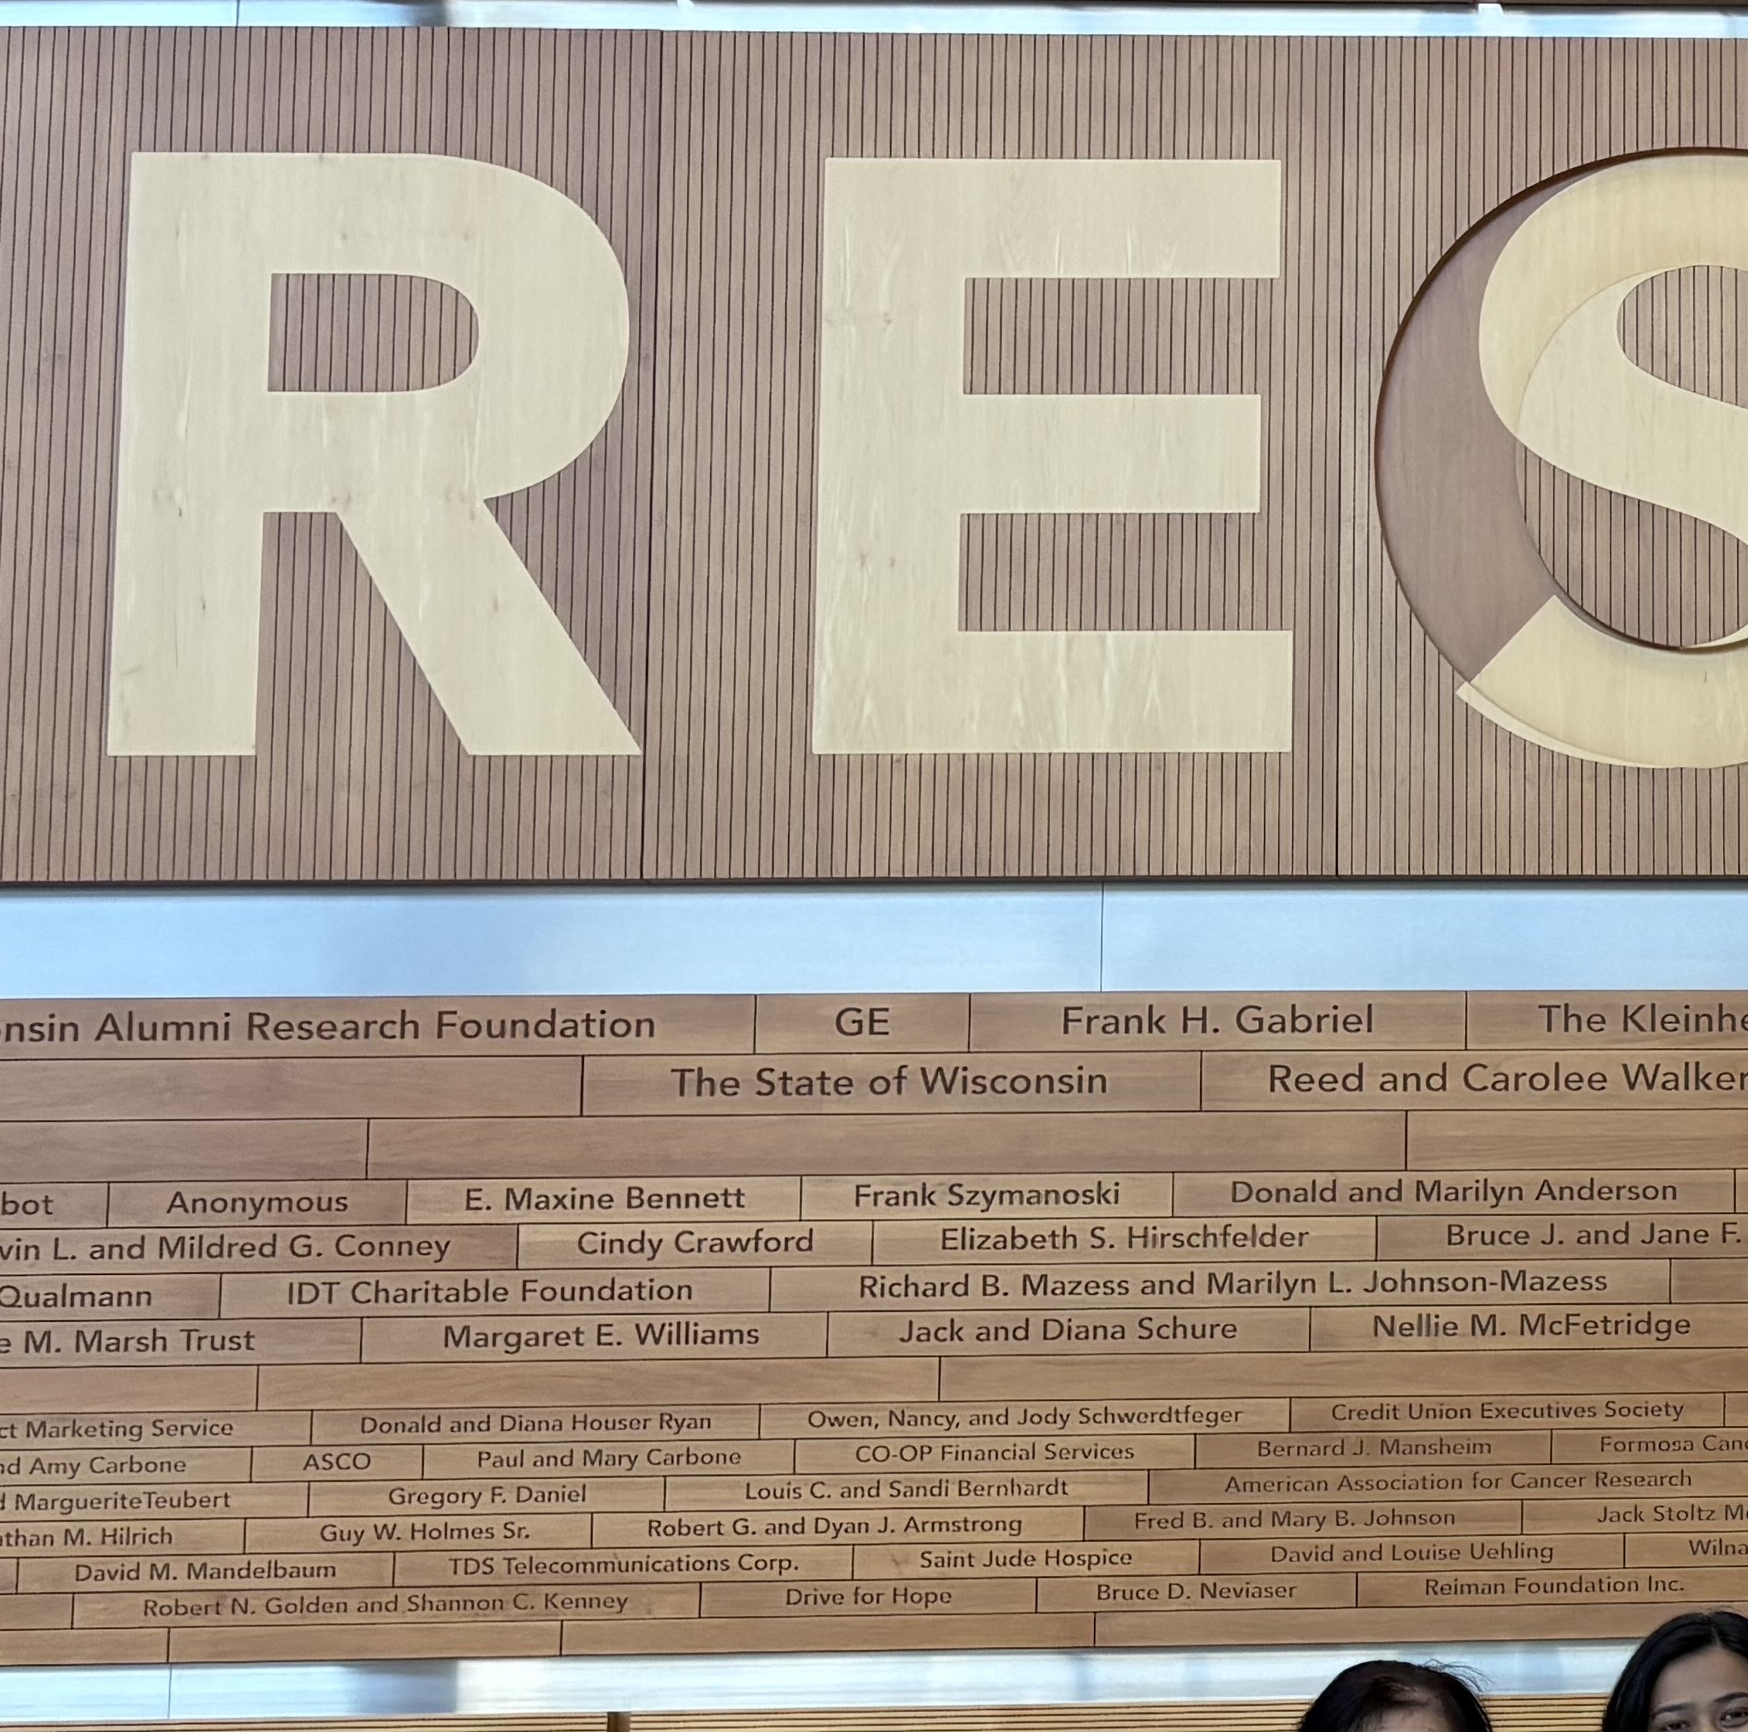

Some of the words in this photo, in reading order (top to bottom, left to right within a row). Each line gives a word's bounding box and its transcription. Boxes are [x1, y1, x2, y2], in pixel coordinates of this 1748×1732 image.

[94, 1010, 231, 1042] Alumni
[247, 1008, 420, 1041] Research
[436, 1007, 655, 1040] Foundation
[835, 1007, 890, 1037] GE
[1062, 1003, 1166, 1035] Frank
[1182, 1005, 1220, 1034] H.
[1235, 1003, 1373, 1034] Gabriel
[1537, 1002, 1607, 1033] The
[670, 1066, 741, 1097] The
[755, 1067, 854, 1097] State
[868, 1064, 909, 1096] of
[919, 1064, 1107, 1095] Wisconsin
[1269, 1061, 1364, 1093] Reed
[1378, 1061, 1447, 1093] and
[1462, 1061, 1608, 1092] Carolee
[166, 1190, 349, 1221] Anonymous
[465, 1187, 492, 1211] E.
[505, 1186, 615, 1211] Maxine
[626, 1186, 746, 1210] Bennett
[854, 1181, 937, 1208] Frank
[947, 1180, 1120, 1214] Szymanoski
[577, 1229, 664, 1262] Cindy
[674, 1227, 814, 1254] Crawford
[941, 1224, 1078, 1251] Elizabeth
[1090, 1225, 1115, 1250] S.
[1128, 1223, 1310, 1249] Hirschfelder
[288, 1281, 341, 1305] IDT
[350, 1278, 509, 1305] Charitable
[521, 1276, 693, 1303] Foundation
[444, 1324, 585, 1355] Margaret
[596, 1323, 623, 1347] E.
[634, 1320, 760, 1346] Williams
[898, 1317, 964, 1343] Jack
[975, 1316, 1030, 1343] and
[1042, 1317, 1126, 1341] Diana
[1137, 1314, 1238, 1340] Schure
[302, 1452, 372, 1471] ASCO
[855, 1444, 933, 1463] CO-OP
[941, 1441, 1036, 1462] Financial
[1044, 1442, 1135, 1461] Services
[388, 1486, 483, 1510] Gregory
[490, 1485, 507, 1504] F.
[516, 1482, 587, 1504] Daniel
[75, 1561, 141, 1582] David
[149, 1562, 178, 1581] M.
[186, 1559, 336, 1580] Mandelbaum
[448, 1556, 495, 1576] TDS
[502, 1554, 731, 1575] Telecommunications
[737, 1553, 799, 1577] Corp.
[920, 1550, 976, 1569] Saint
[982, 1548, 1037, 1568] Jude
[1044, 1548, 1133, 1572] Hospice
[785, 1587, 845, 1606] Drive
[853, 1586, 885, 1605] for
[892, 1586, 952, 1609] Hope
[1097, 1583, 1160, 1601] Bruce
[1167, 1582, 1192, 1600] D.
[1200, 1581, 1297, 1600] Neviaser
